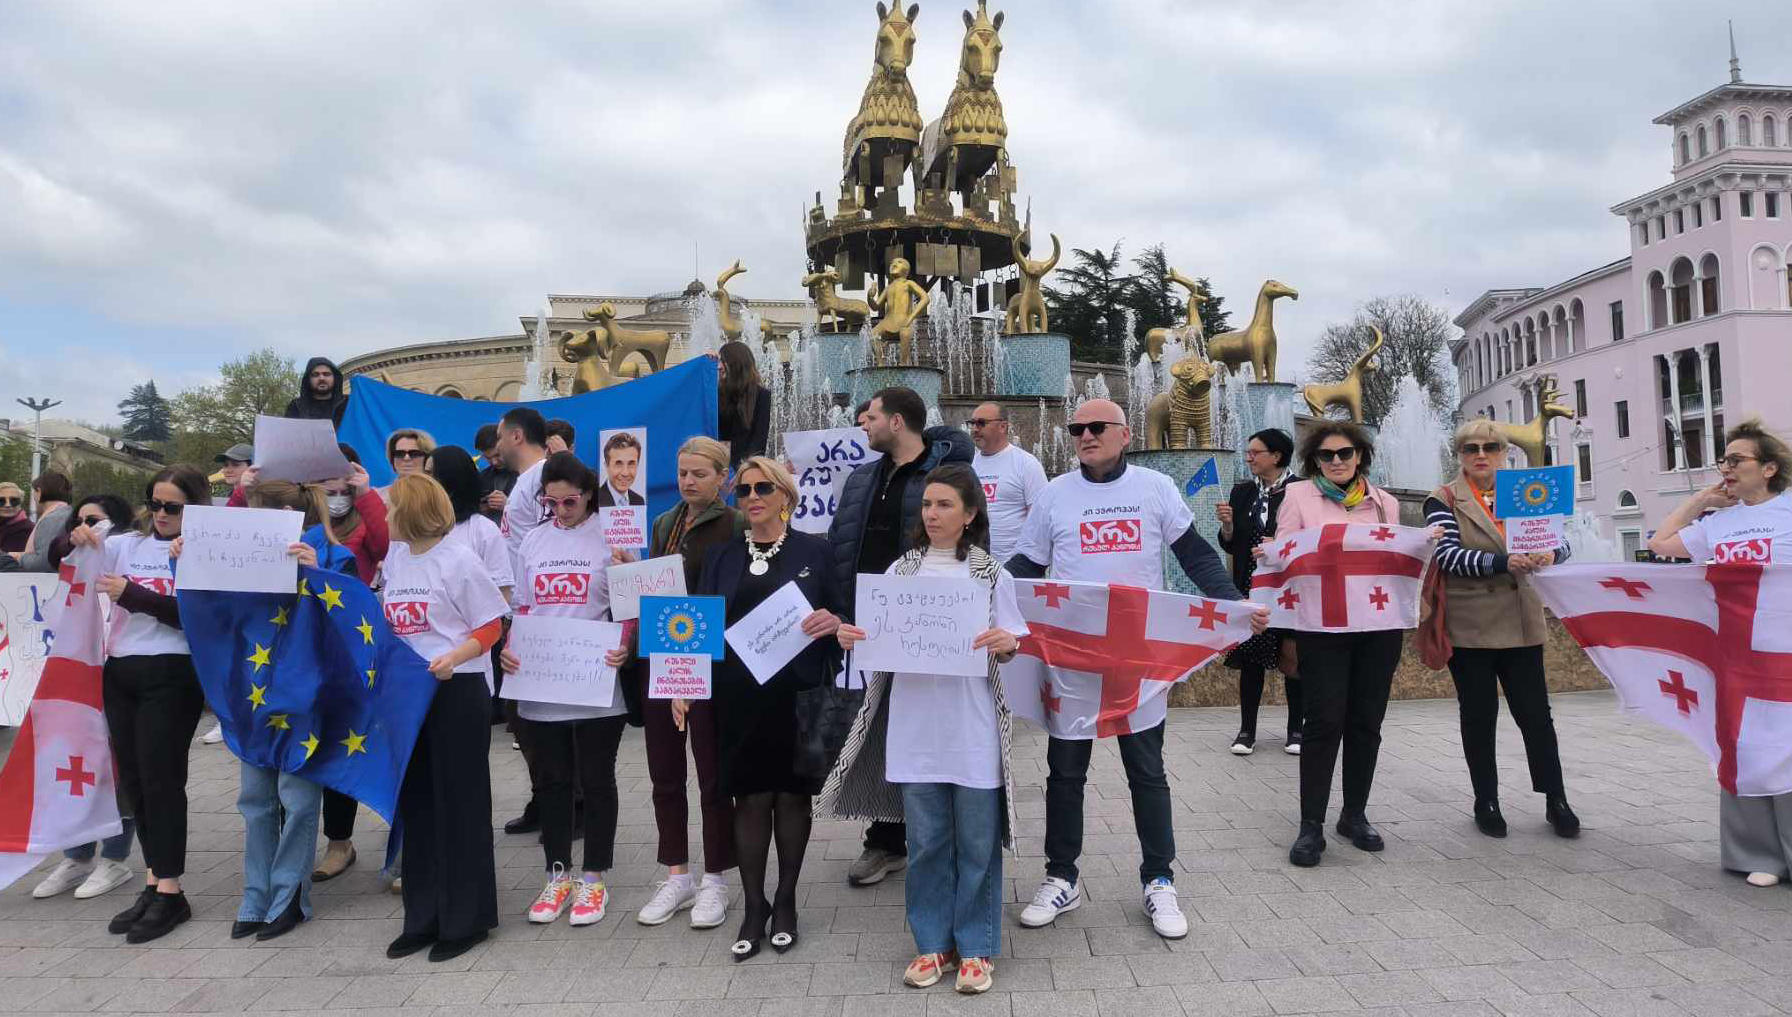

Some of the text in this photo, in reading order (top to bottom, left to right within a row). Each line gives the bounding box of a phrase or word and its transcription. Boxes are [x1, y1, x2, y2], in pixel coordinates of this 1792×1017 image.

[817, 439, 865, 463] არა
[1082, 521, 1139, 544] არა
[1716, 539, 1769, 563] არა
[536, 574, 587, 596] არა
[386, 603, 426, 626] არა
[869, 609, 894, 641] ეს
